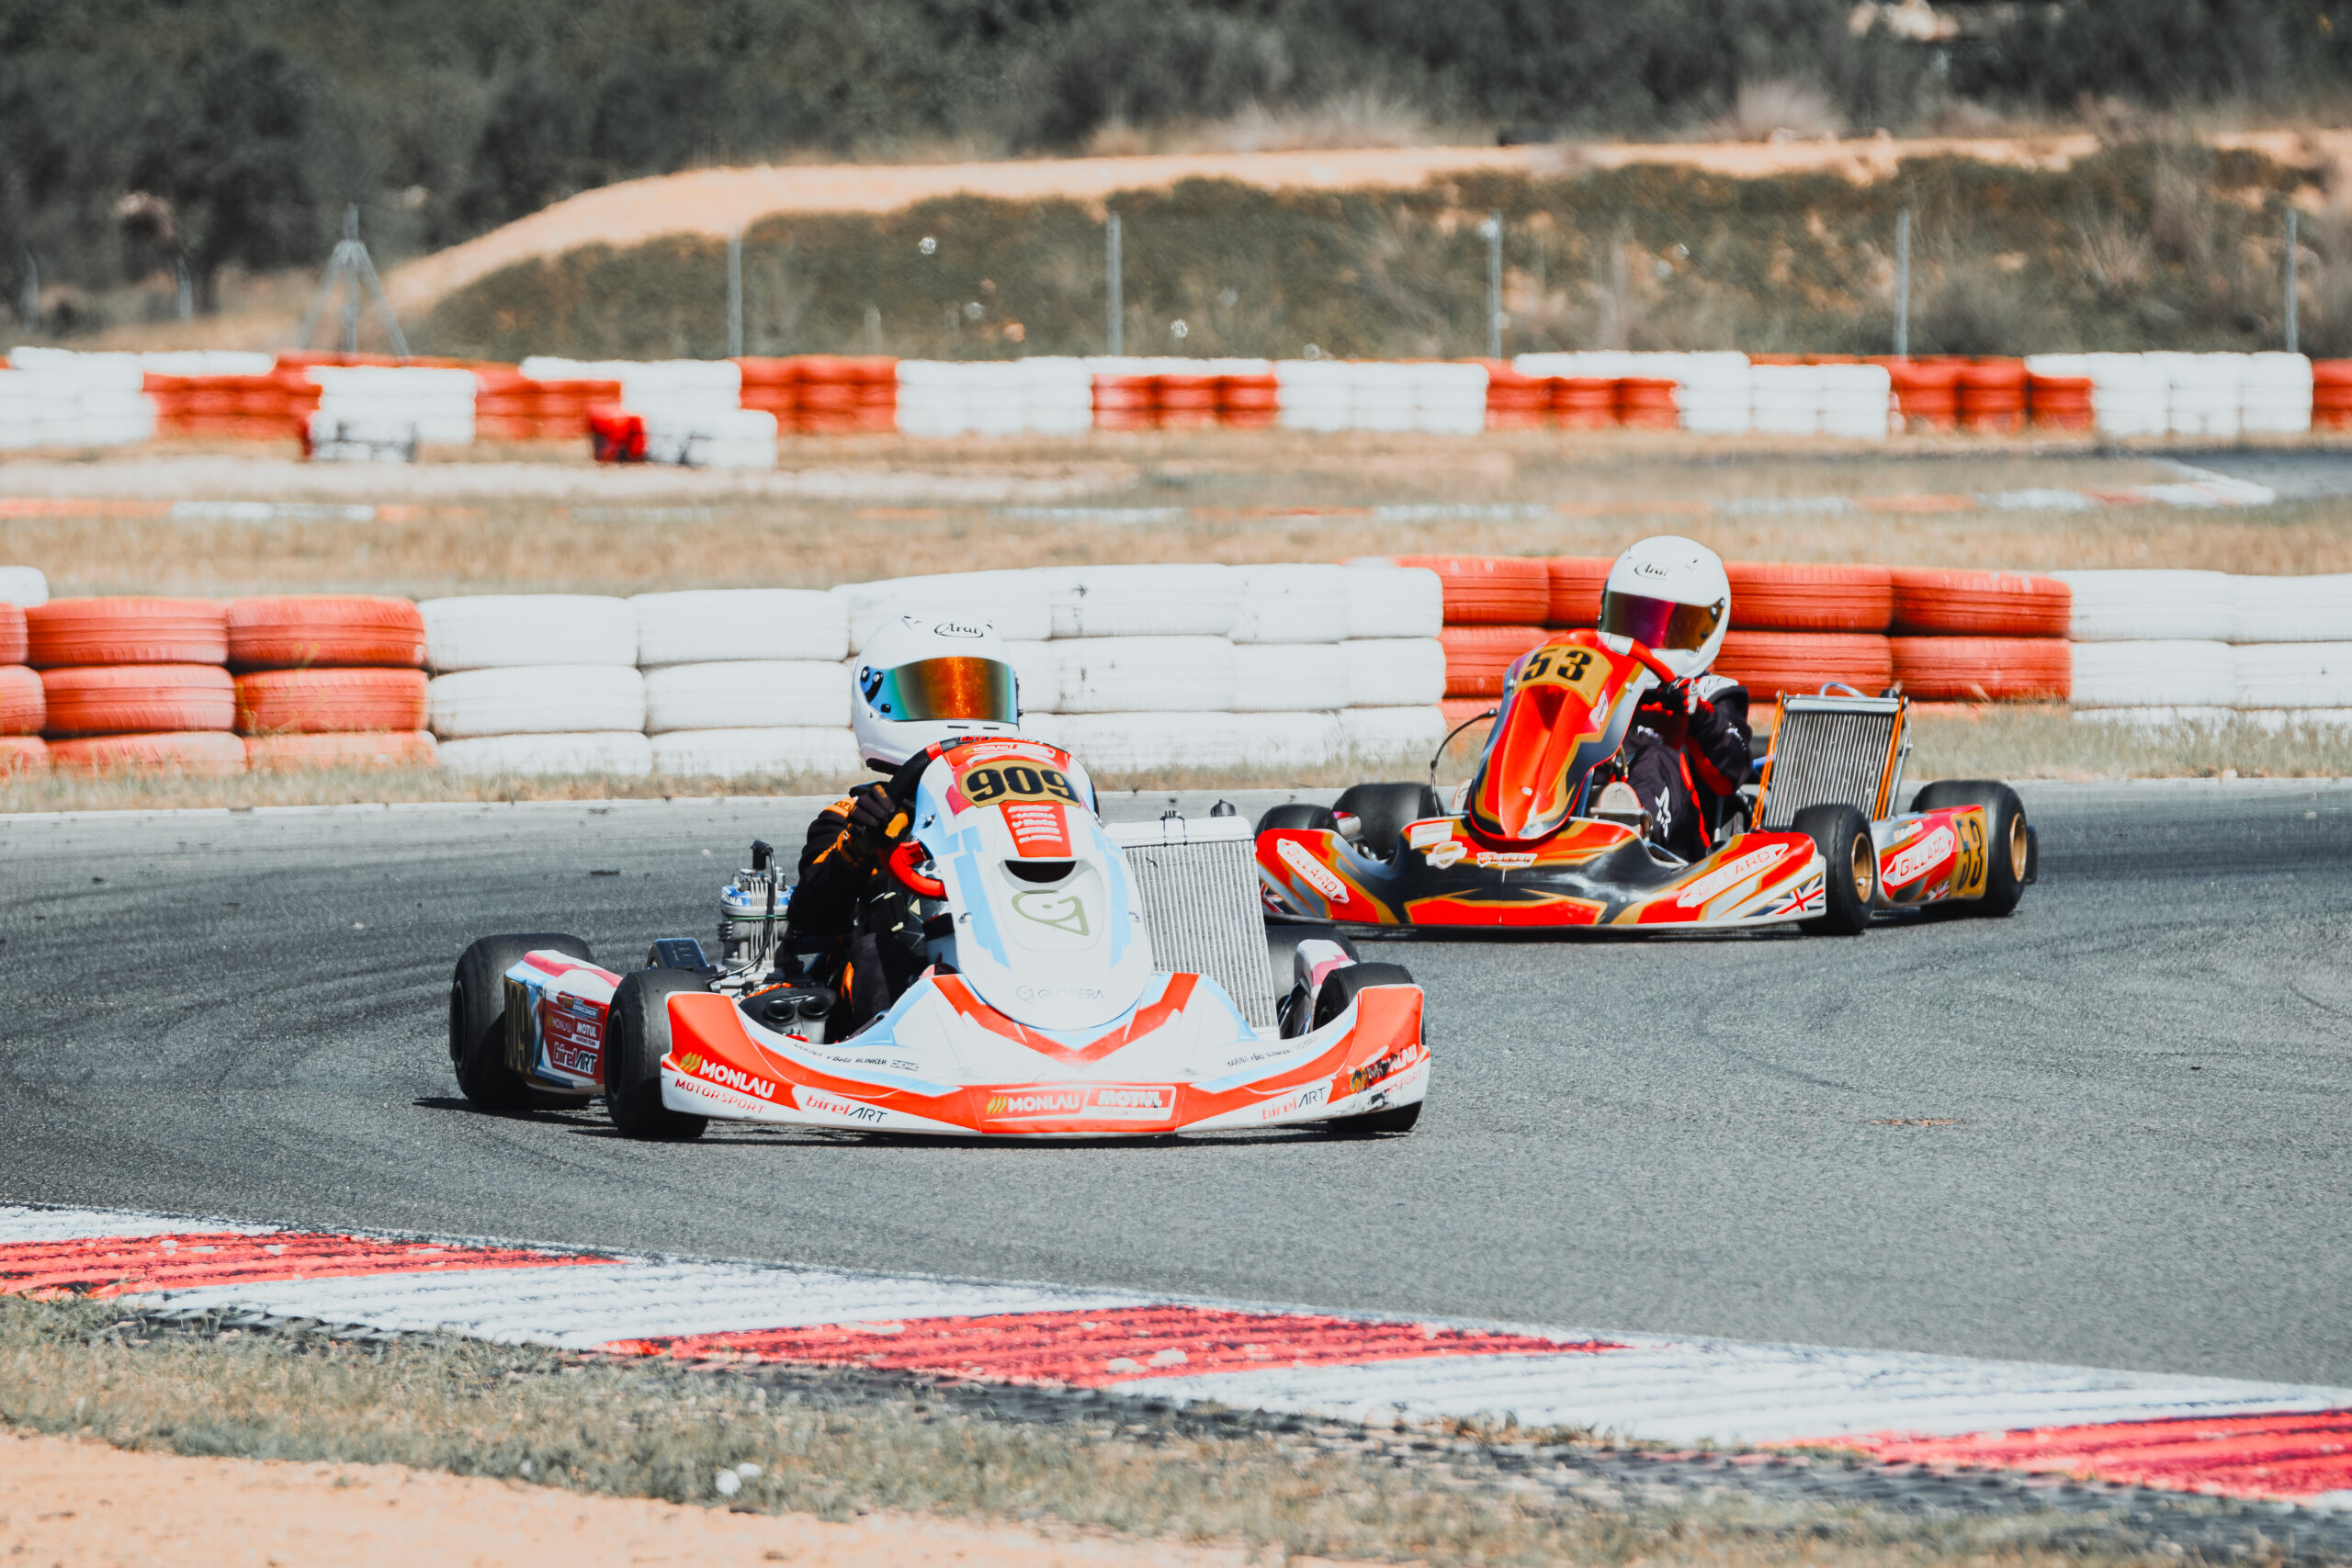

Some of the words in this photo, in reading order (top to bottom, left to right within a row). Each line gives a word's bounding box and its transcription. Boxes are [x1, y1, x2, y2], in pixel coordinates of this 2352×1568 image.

[1522, 649, 1592, 682] 53
[966, 765, 1080, 807] 909
[1900, 835, 1947, 877] GILLARD
[1956, 819, 1984, 891] 53
[552, 1017, 572, 1033] MONLAU
[576, 1021, 597, 1038] MOTUL
[674, 1077, 768, 1114] MOTORSPORT
[699, 1059, 776, 1099] MONLAU
[1008, 1094, 1080, 1112] MONLAU
[1098, 1089, 1162, 1108] MOTUL
